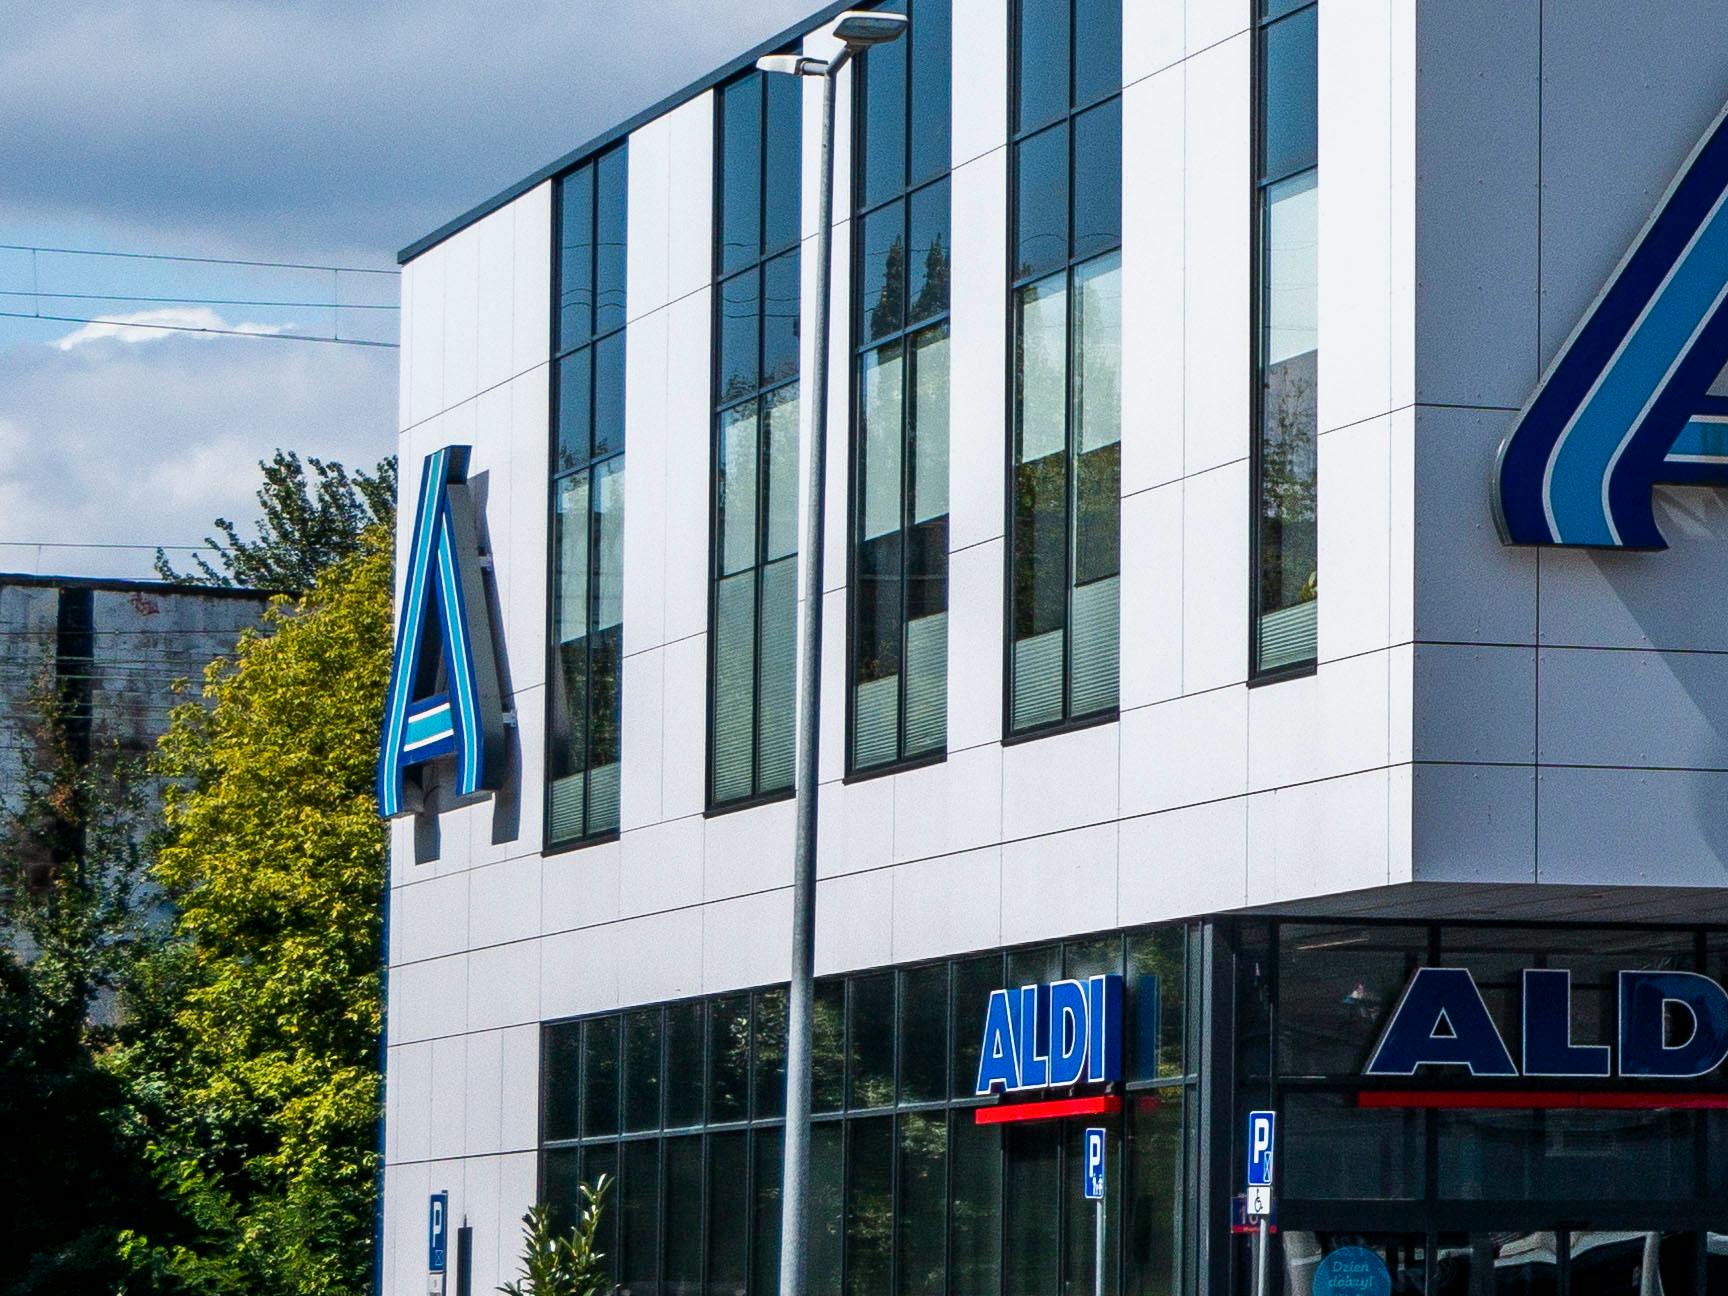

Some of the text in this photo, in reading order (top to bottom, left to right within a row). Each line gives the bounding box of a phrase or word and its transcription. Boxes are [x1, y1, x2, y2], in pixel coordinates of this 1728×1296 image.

[976, 974, 1108, 1096] ALDI
[1089, 1135, 1101, 1178] P
[1253, 1118, 1269, 1164] P
[433, 1202, 442, 1248] P
